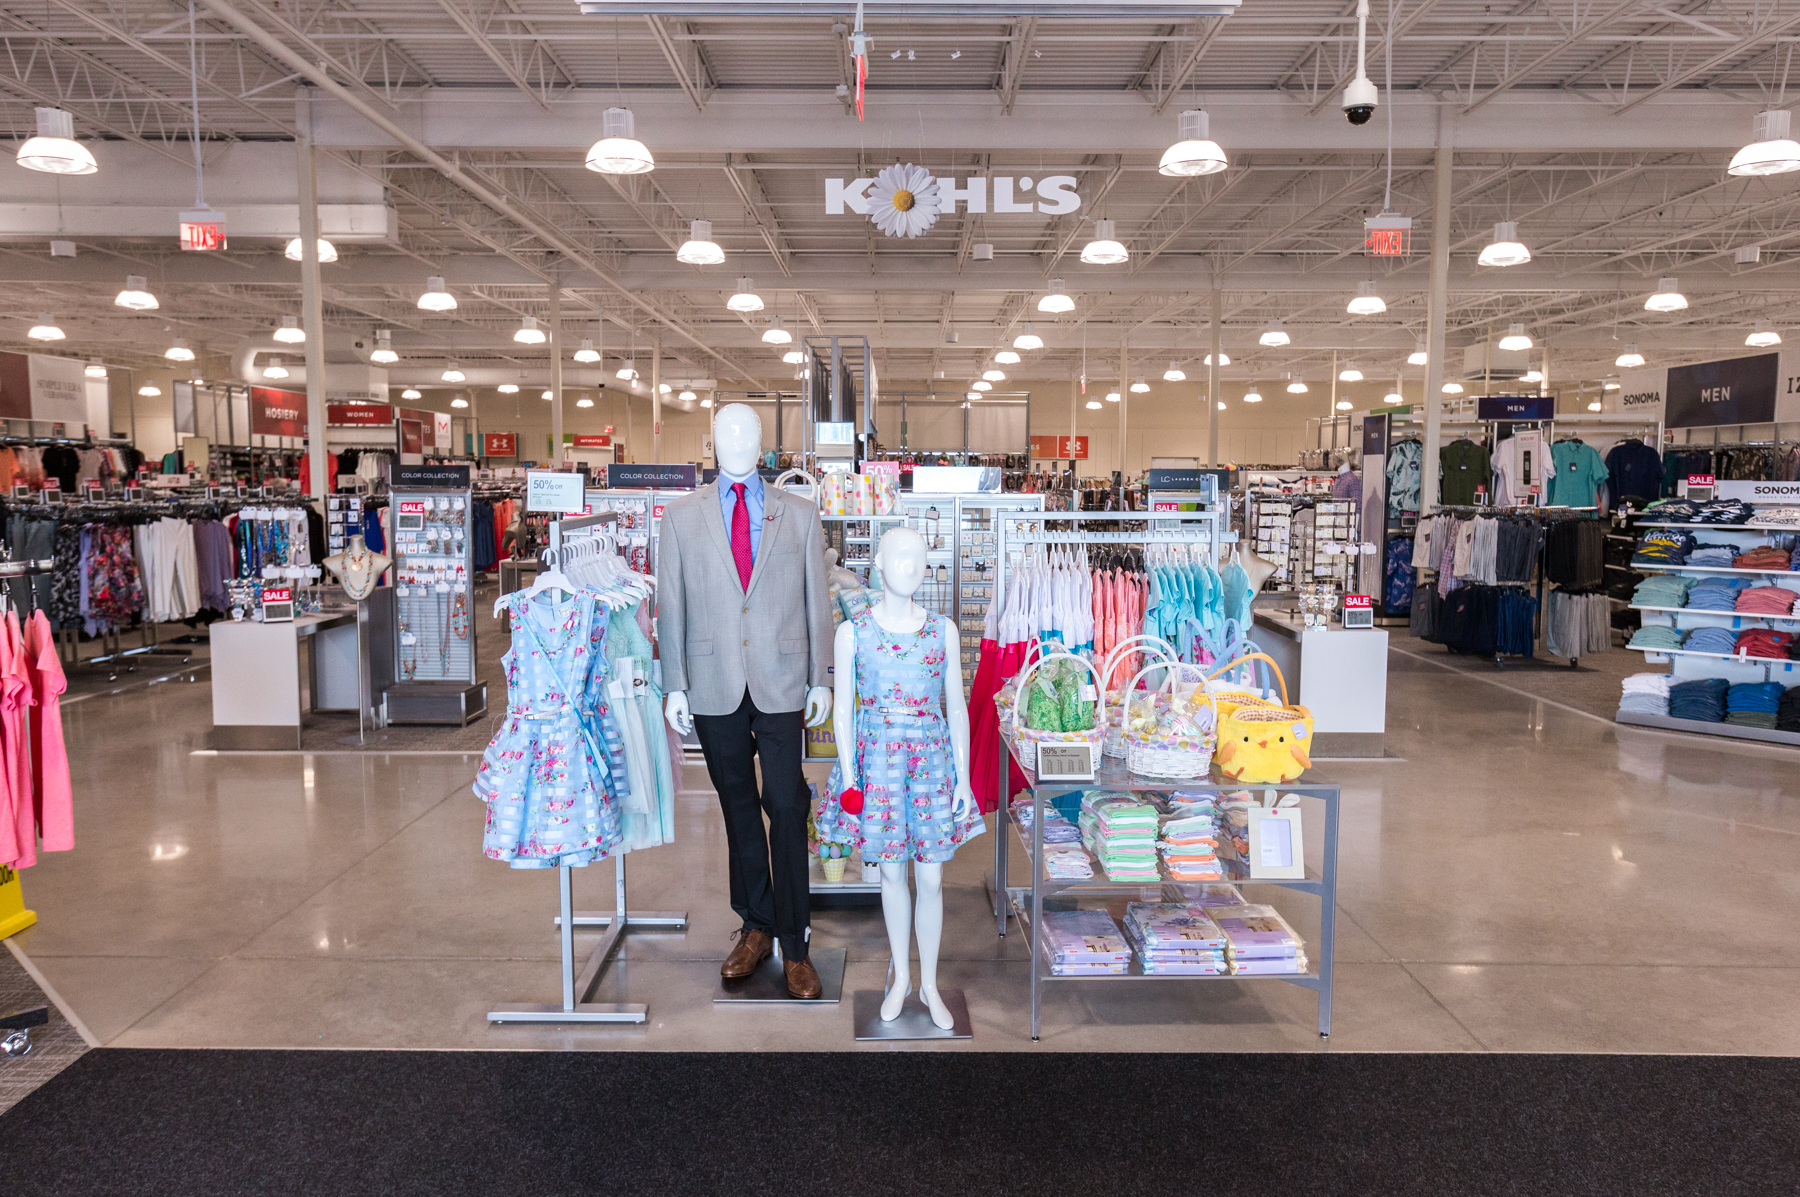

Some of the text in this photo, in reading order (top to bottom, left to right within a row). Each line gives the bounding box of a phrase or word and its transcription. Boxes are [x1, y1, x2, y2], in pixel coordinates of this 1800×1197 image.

[825, 175, 1081, 215] KHL'S
[1623, 391, 1660, 405] SONOMA
[1701, 386, 1731, 403] MEN
[265, 407, 299, 421] HOSIERY
[533, 479, 554, 490] 50%
[1689, 476, 1713, 484] SALE
[402, 504, 424, 512] SALE
[1155, 504, 1178, 512] SALE
[263, 591, 290, 600] SALE
[1345, 597, 1370, 606] SALE
[1042, 747, 1057, 755] 50%
